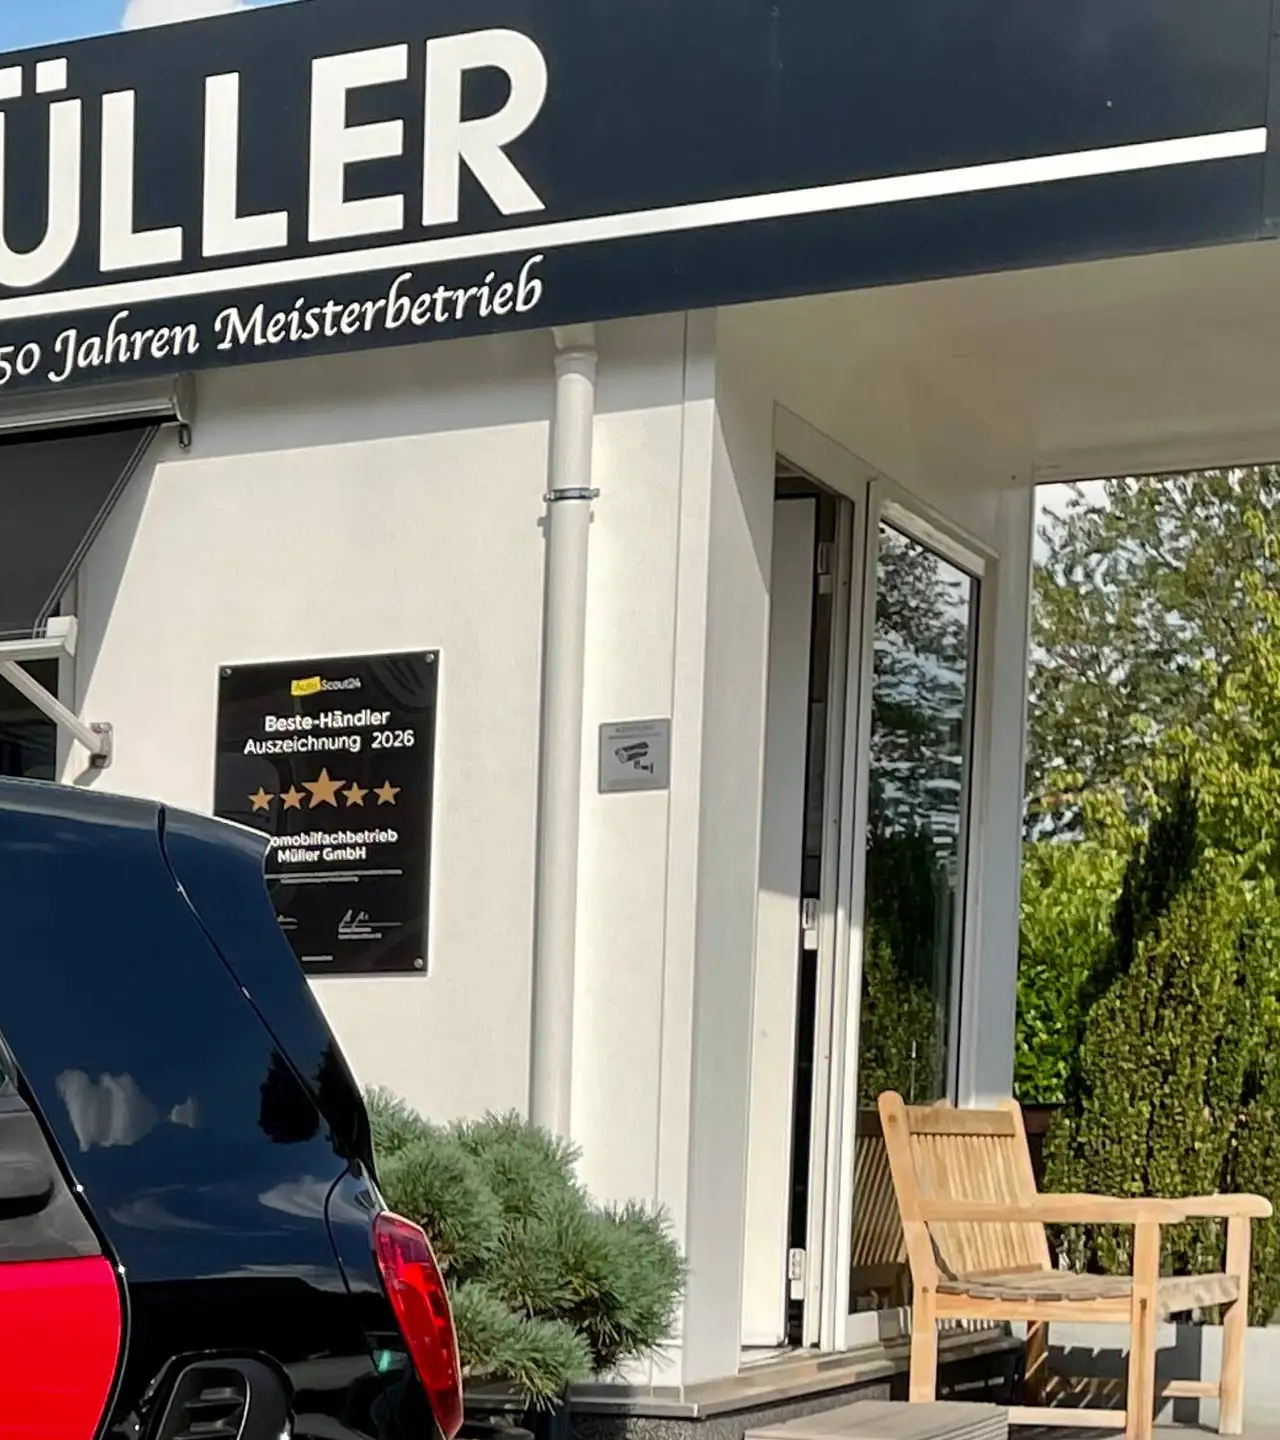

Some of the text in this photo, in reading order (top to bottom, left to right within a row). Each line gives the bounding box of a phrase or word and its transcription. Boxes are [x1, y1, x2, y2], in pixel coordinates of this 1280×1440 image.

[47, 311, 199, 383] Jahren
[214, 254, 543, 350] Meisterbetrieb
[264, 709, 390, 732] Beste-Händler
[244, 730, 415, 755] Auszeichnung 2026
[270, 829, 398, 847] omobilfachbetrieb
[278, 847, 367, 863] Müller GmbH
